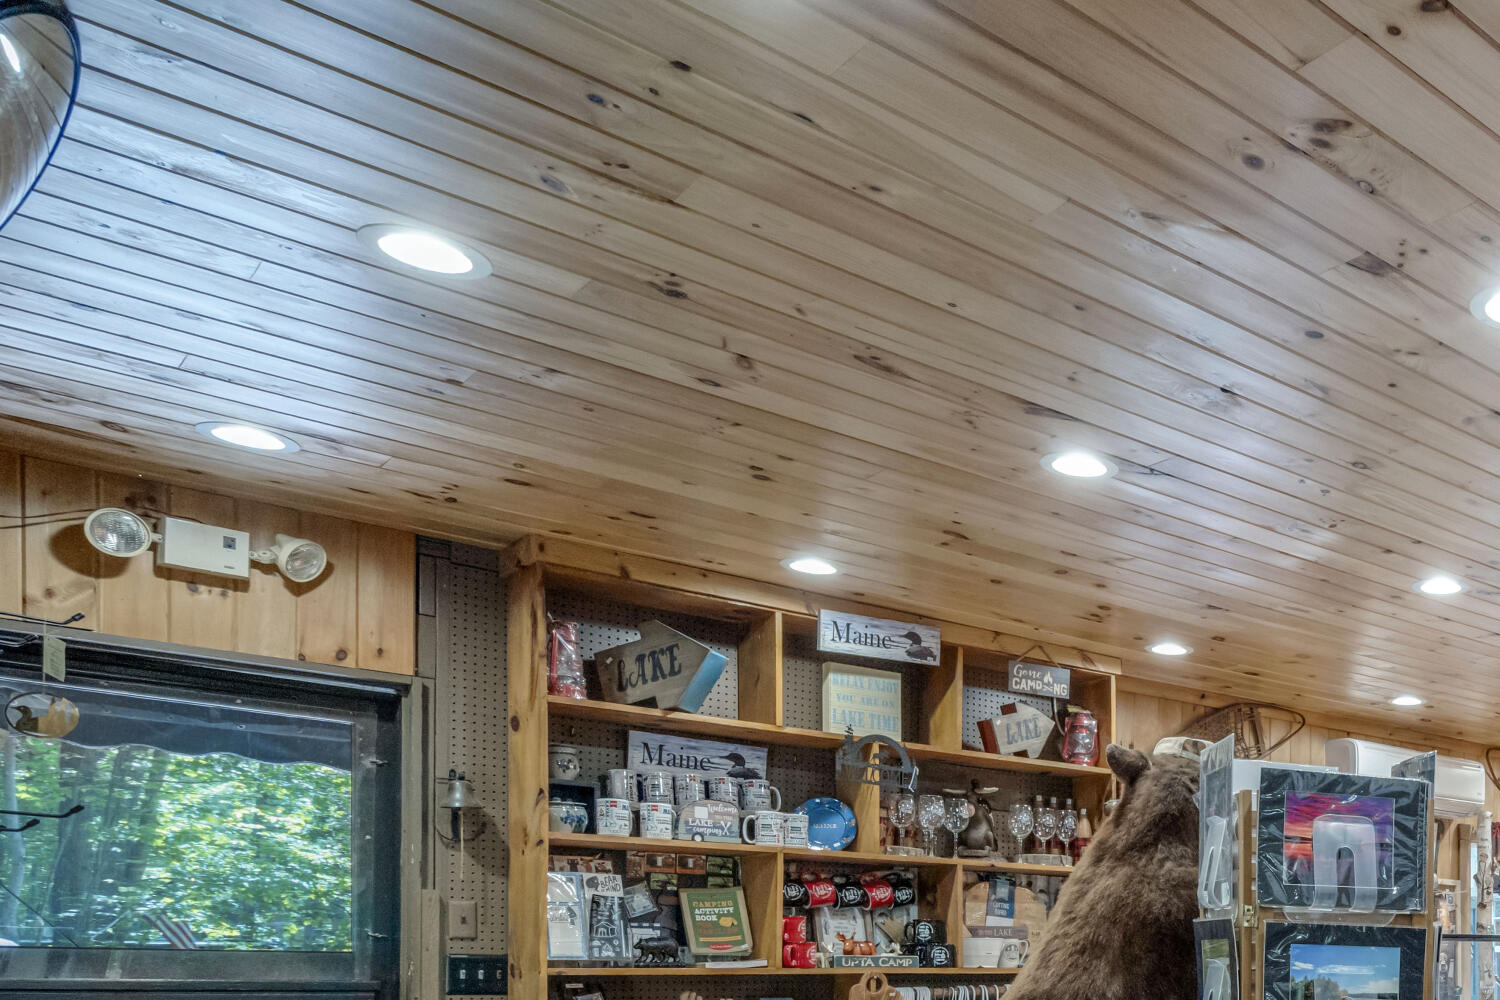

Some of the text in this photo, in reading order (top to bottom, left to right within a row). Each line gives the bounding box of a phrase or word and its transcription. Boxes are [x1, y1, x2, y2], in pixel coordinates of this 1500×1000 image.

[830, 620, 892, 649] Maine
[616, 643, 682, 692] LAKE
[1013, 664, 1042, 679] Gone
[831, 672, 898, 695] RELAX ENJOY
[831, 707, 899, 733] LAKE TIME
[1006, 716, 1041, 745] LAKE
[640, 742, 712, 771] Maine
[688, 818, 714, 827] LAKE
[692, 900, 734, 908] CAMPING
[694, 906, 734, 915] ACTIVITY
[695, 914, 718, 922] BOOK
[994, 927, 1013, 937] LAKE
[879, 956, 914, 967] CAMP
